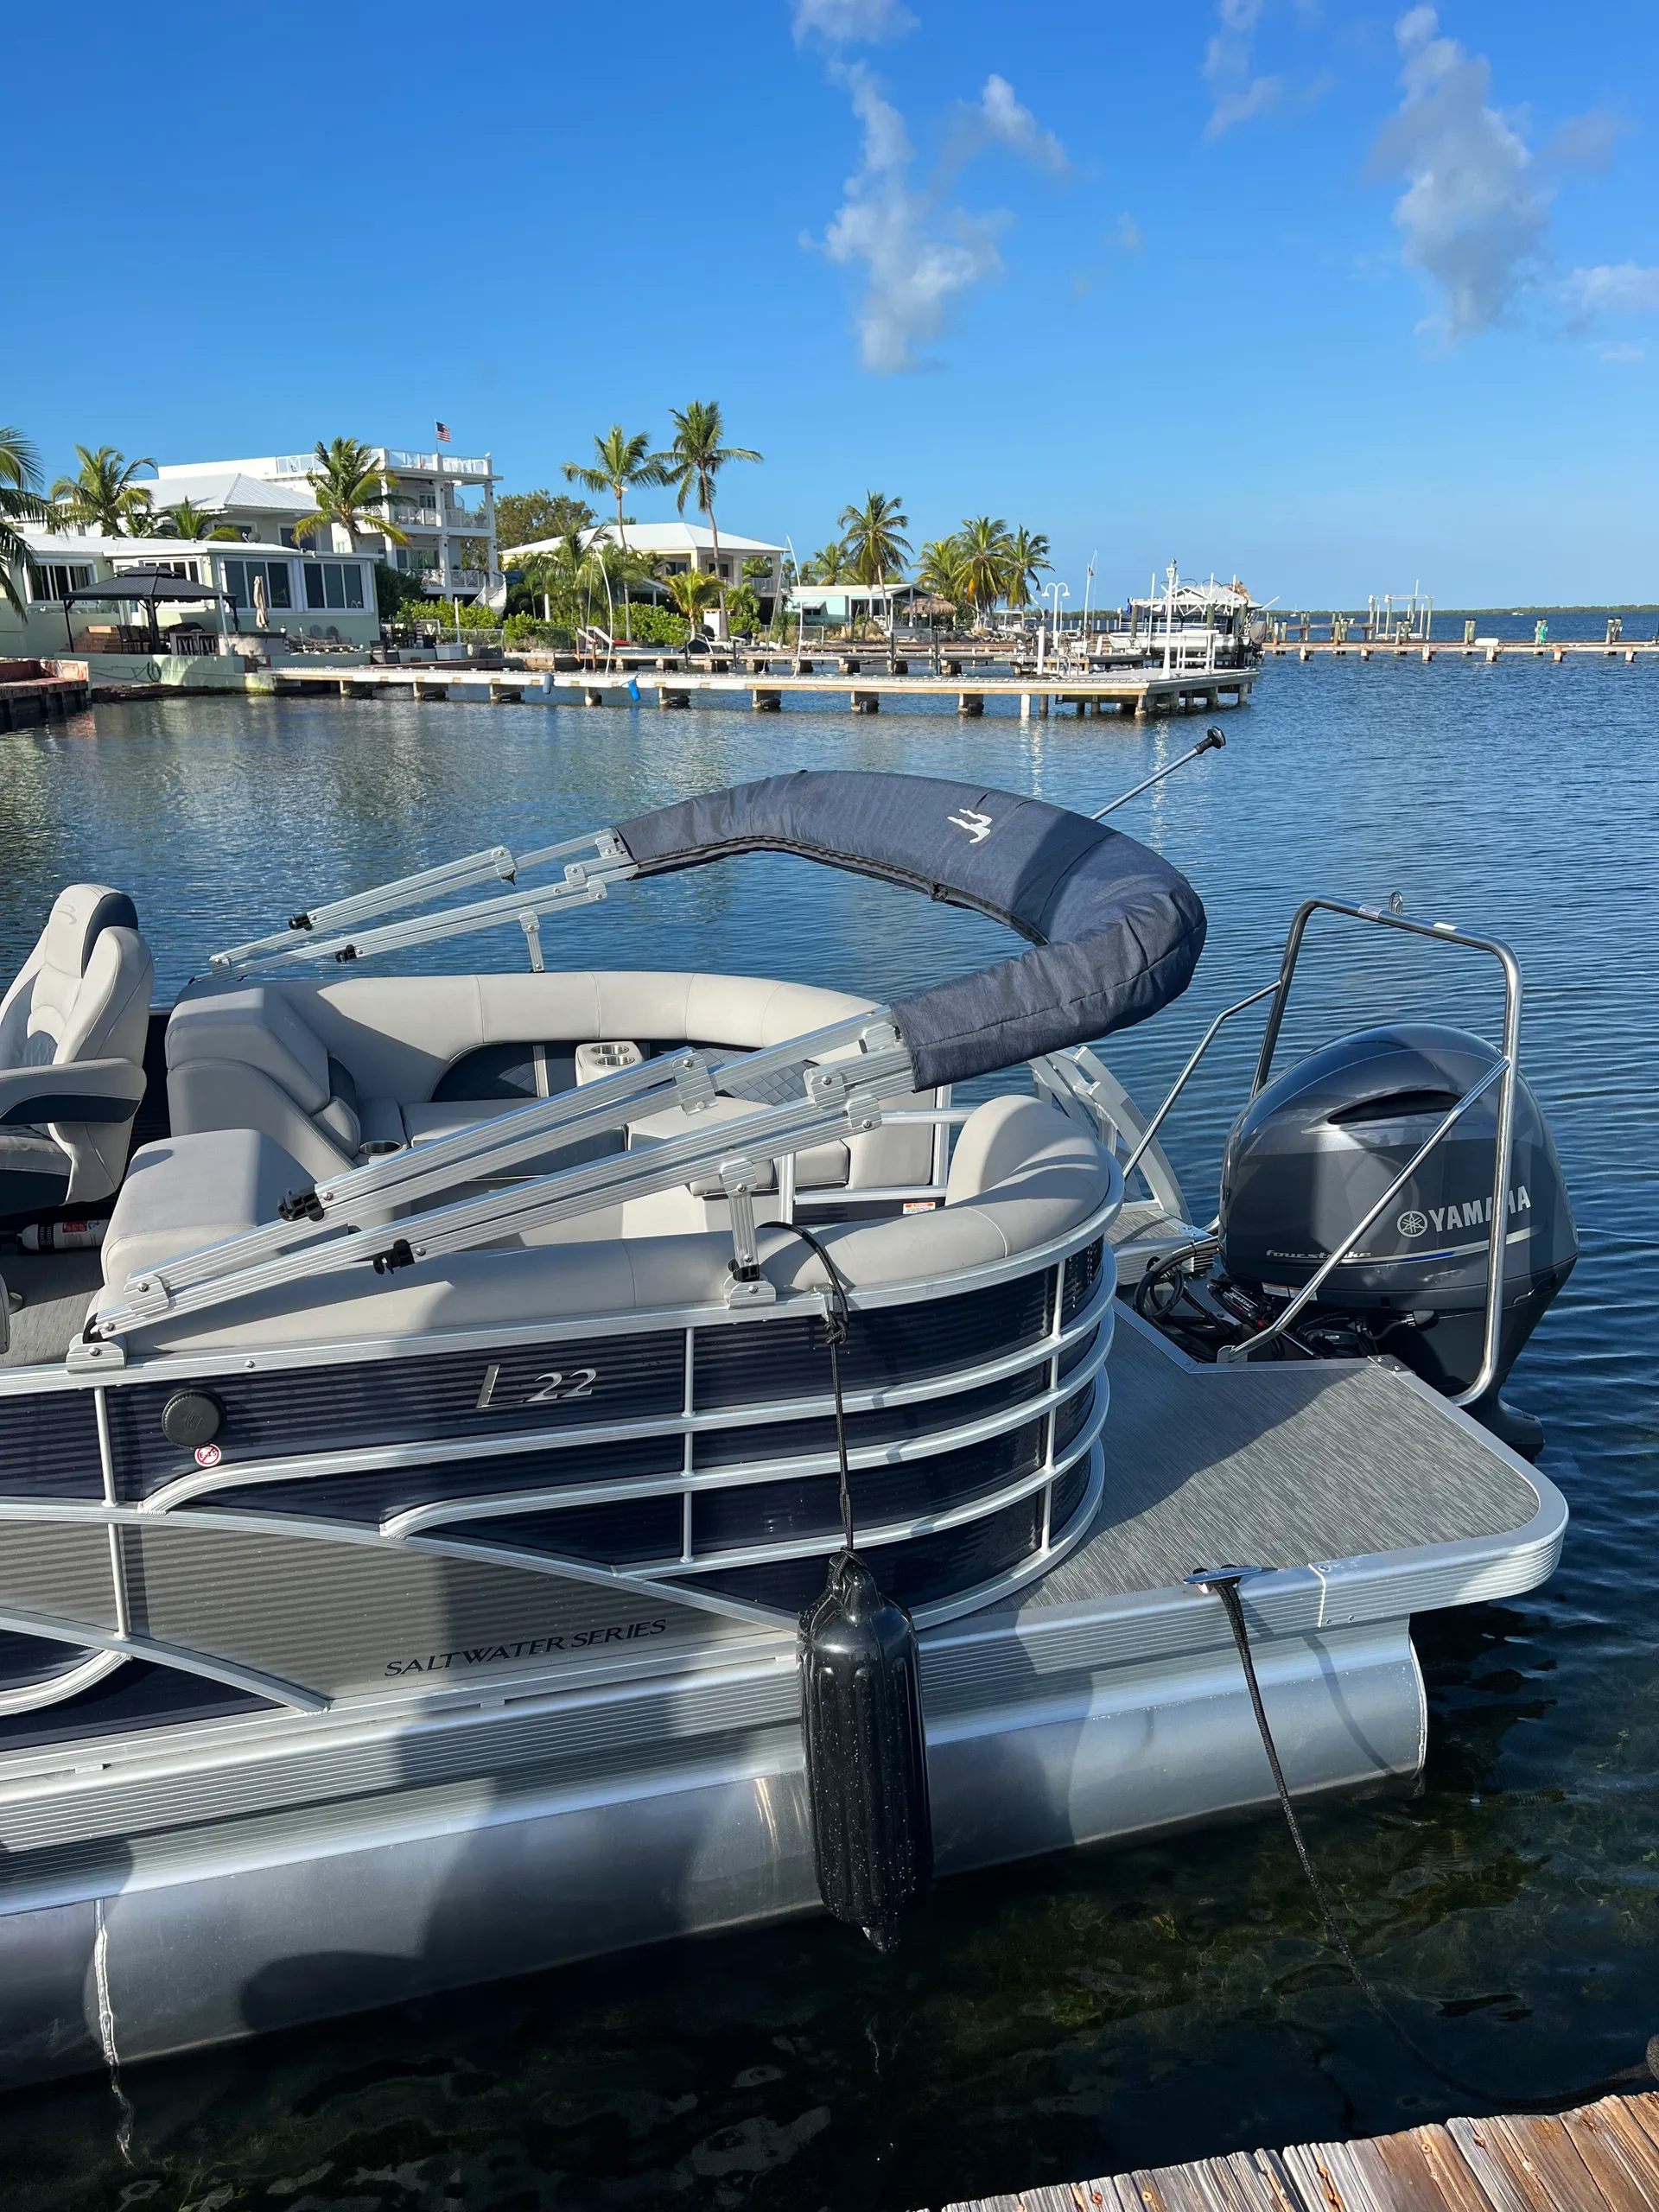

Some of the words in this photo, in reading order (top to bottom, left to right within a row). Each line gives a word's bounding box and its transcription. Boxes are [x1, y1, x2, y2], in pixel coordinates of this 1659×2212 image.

[1265, 1249, 1371, 1259] fourstke
[384, 1637, 565, 1676] SALTWATER
[570, 1619, 666, 1648] SERIES
